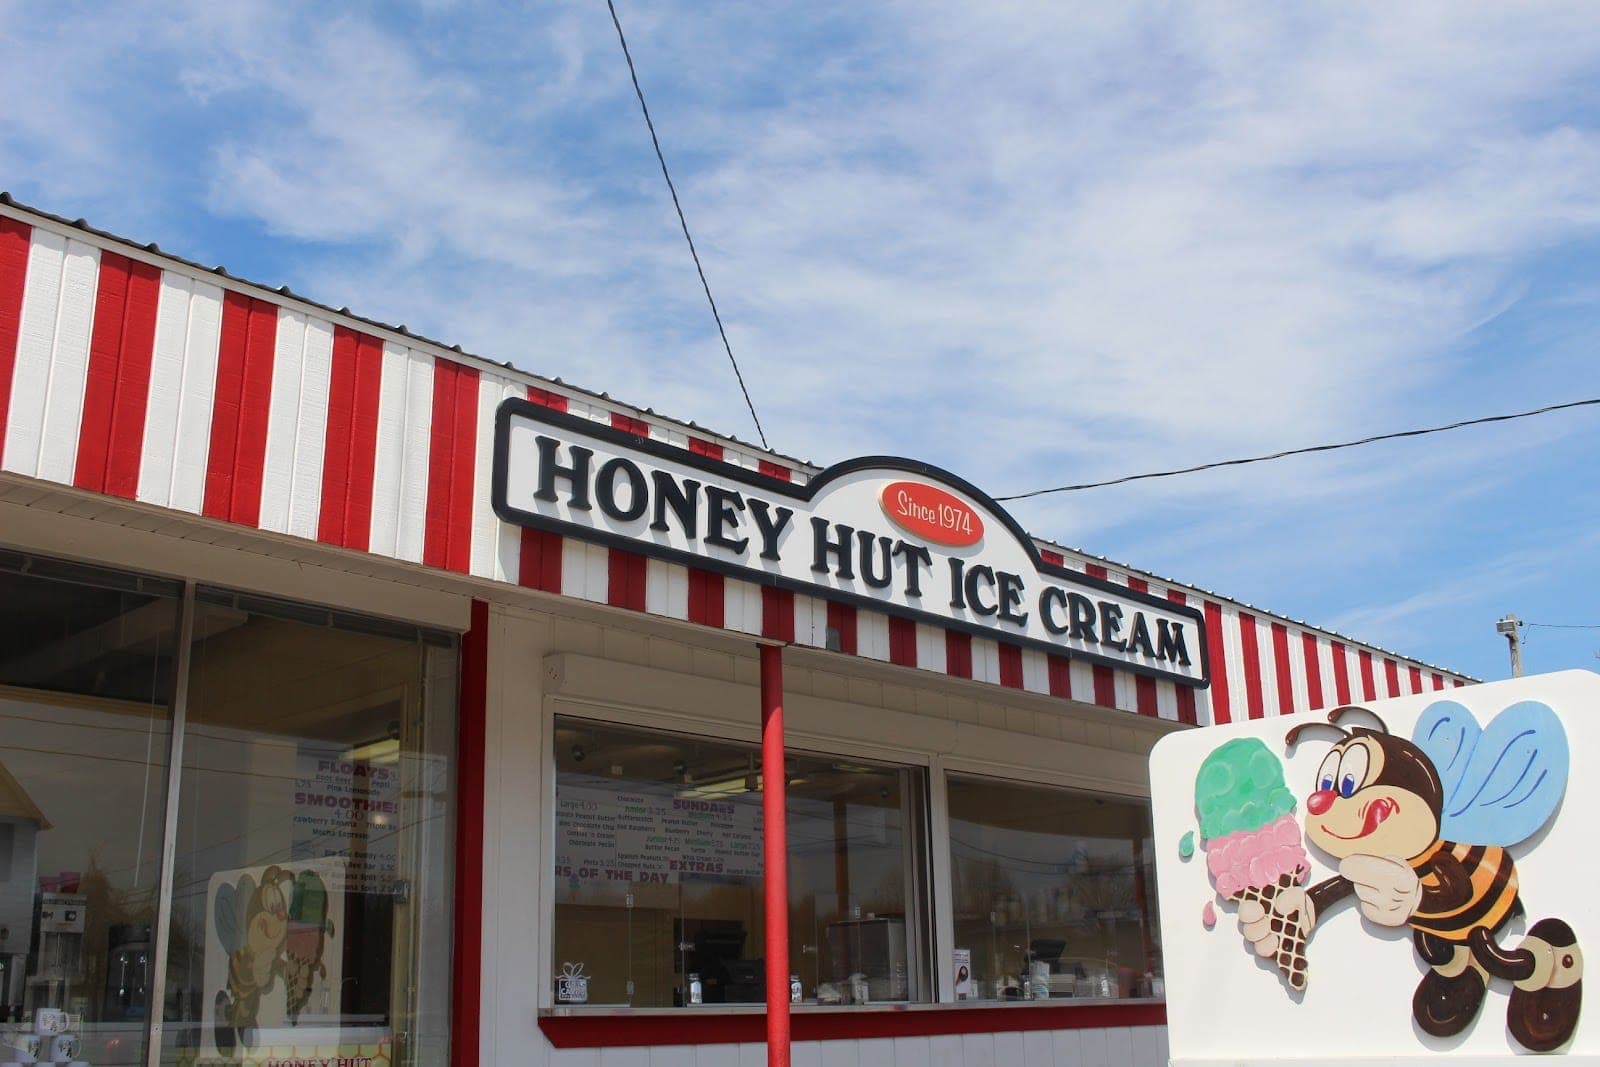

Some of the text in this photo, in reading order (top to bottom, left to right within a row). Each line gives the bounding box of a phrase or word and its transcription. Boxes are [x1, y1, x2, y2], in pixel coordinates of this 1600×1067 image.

[897, 490, 973, 535] Since 1974
[534, 434, 1192, 666] HONEY HUT ICE CREAM
[318, 760, 390, 779] FLOATS
[672, 799, 735, 814] SUNDAES
[669, 860, 723, 873] EXTRAS
[579, 868, 599, 878] OF
[605, 869, 632, 881] THE
[639, 871, 669, 883] DAY
